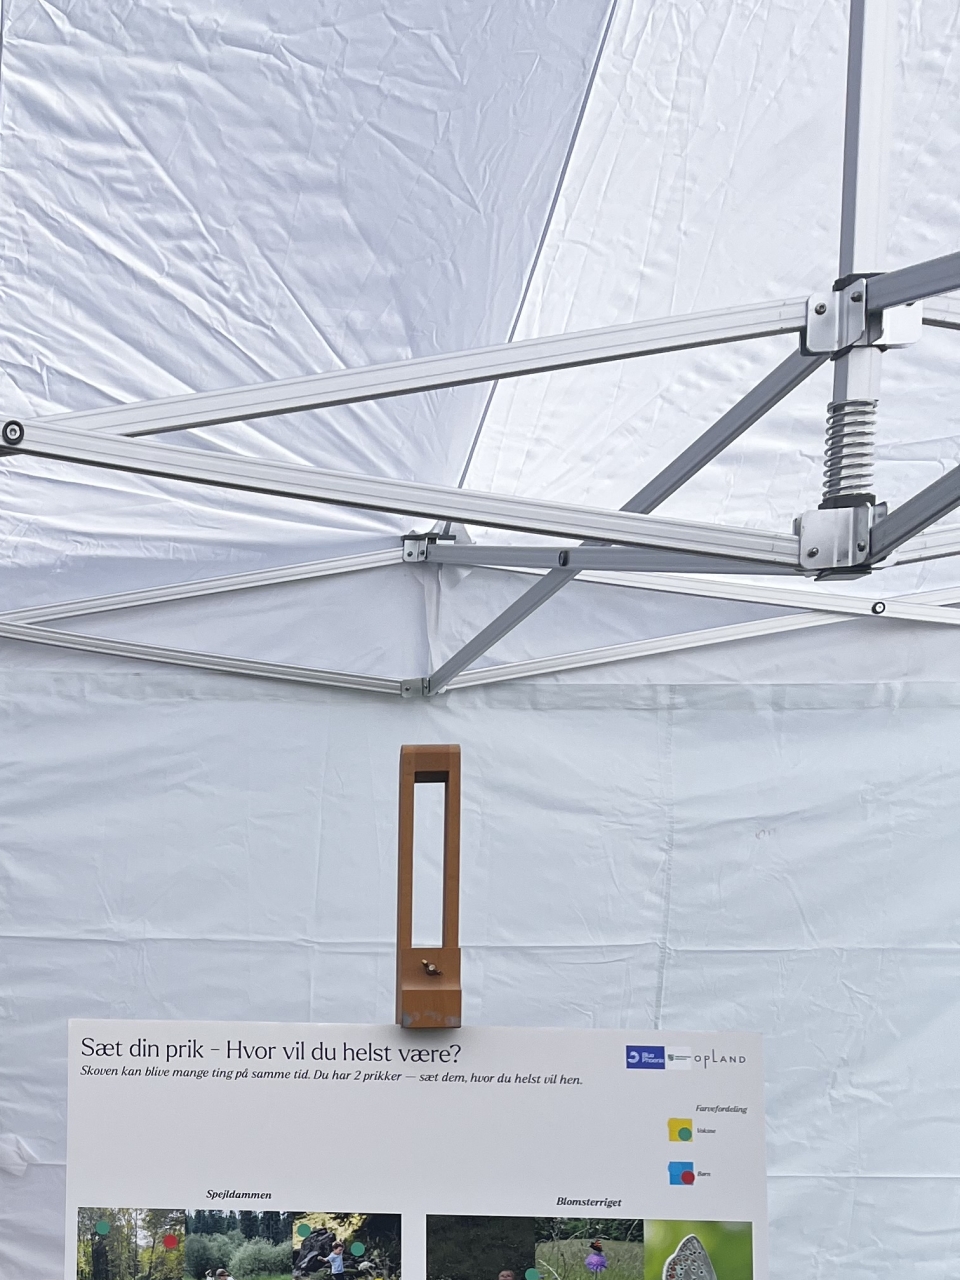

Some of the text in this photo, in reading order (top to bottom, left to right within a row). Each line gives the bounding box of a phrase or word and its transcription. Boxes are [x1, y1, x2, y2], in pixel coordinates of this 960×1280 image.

[81, 1037, 123, 1058] Sæt
[129, 1037, 160, 1058] din
[165, 1038, 204, 1063] prik
[226, 1039, 277, 1060] Hvor
[282, 1040, 305, 1061] vil
[310, 1040, 336, 1061] du
[342, 1041, 392, 1062] helst
[397, 1042, 462, 1064] være?
[79, 1064, 119, 1077] Skoven
[120, 1065, 142, 1077] kan
[144, 1065, 170, 1077] blive
[171, 1068, 210, 1080] mange
[211, 1067, 234, 1081] ting
[234, 1066, 249, 1081] på
[250, 1070, 291, 1080] samme
[293, 1068, 311, 1080] tid.
[312, 1068, 329, 1080] Du
[331, 1068, 352, 1081] har
[353, 1069, 362, 1081] 2
[362, 1069, 403, 1084] prikker
[418, 1072, 439, 1082] sæt
[441, 1071, 468, 1084] dem,
[469, 1072, 495, 1084] hvor
[496, 1072, 512, 1084] du
[513, 1072, 541, 1084] helst
[543, 1073, 558, 1085] vil
[559, 1073, 583, 1085] hen.
[695, 1104, 748, 1115] Farvefordeling
[205, 1189, 272, 1201] Spejldammen
[555, 1196, 622, 1209] Blomsterriget
